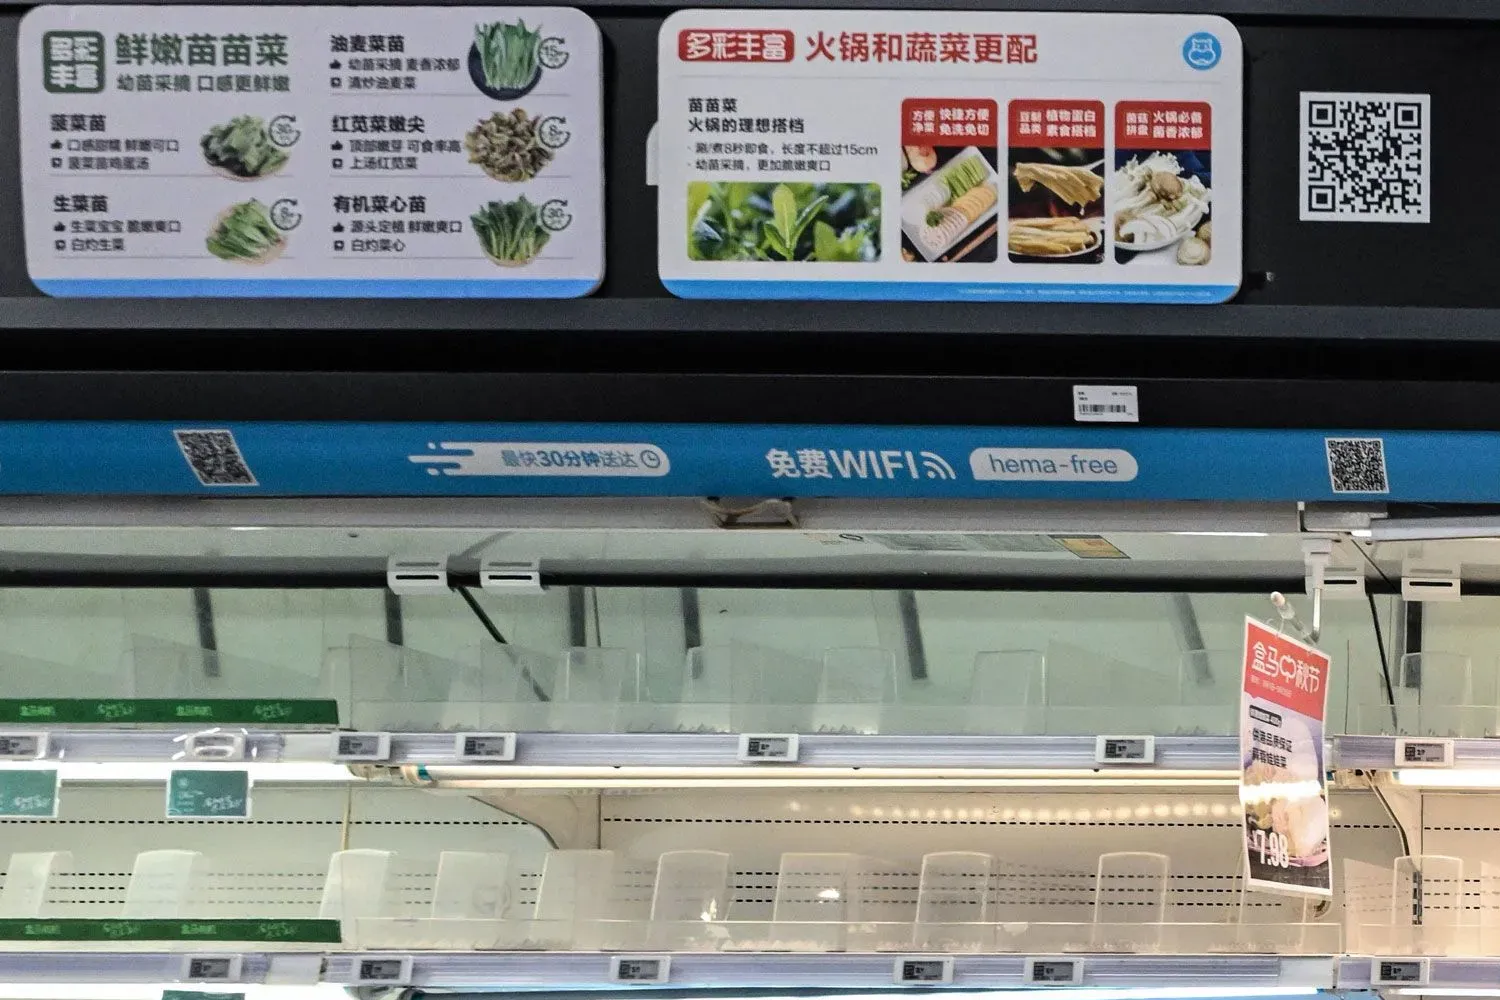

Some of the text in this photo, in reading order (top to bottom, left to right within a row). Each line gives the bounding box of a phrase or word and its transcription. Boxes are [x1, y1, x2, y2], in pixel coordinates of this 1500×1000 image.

[115, 33, 289, 67] 鲜嫩苗苗菜
[330, 35, 404, 53] 油麦菜苗
[686, 31, 1038, 64] 多彩丰富 火锅和蔬菜更配
[688, 98, 738, 113] 苗苗菜
[50, 114, 106, 132] 菠菜苗
[332, 115, 425, 133] 红苋菜嫩尖
[688, 117, 805, 134] 火锅的理想搭档
[54, 195, 108, 213] 生菜苗
[333, 195, 426, 213] 有机菜心苗
[501, 449, 638, 468] 最快30分钟送达
[765, 448, 918, 480] 免费WIFI
[989, 453, 1118, 475] hema-free
[1252, 641, 1321, 694] 盒马中秋节
